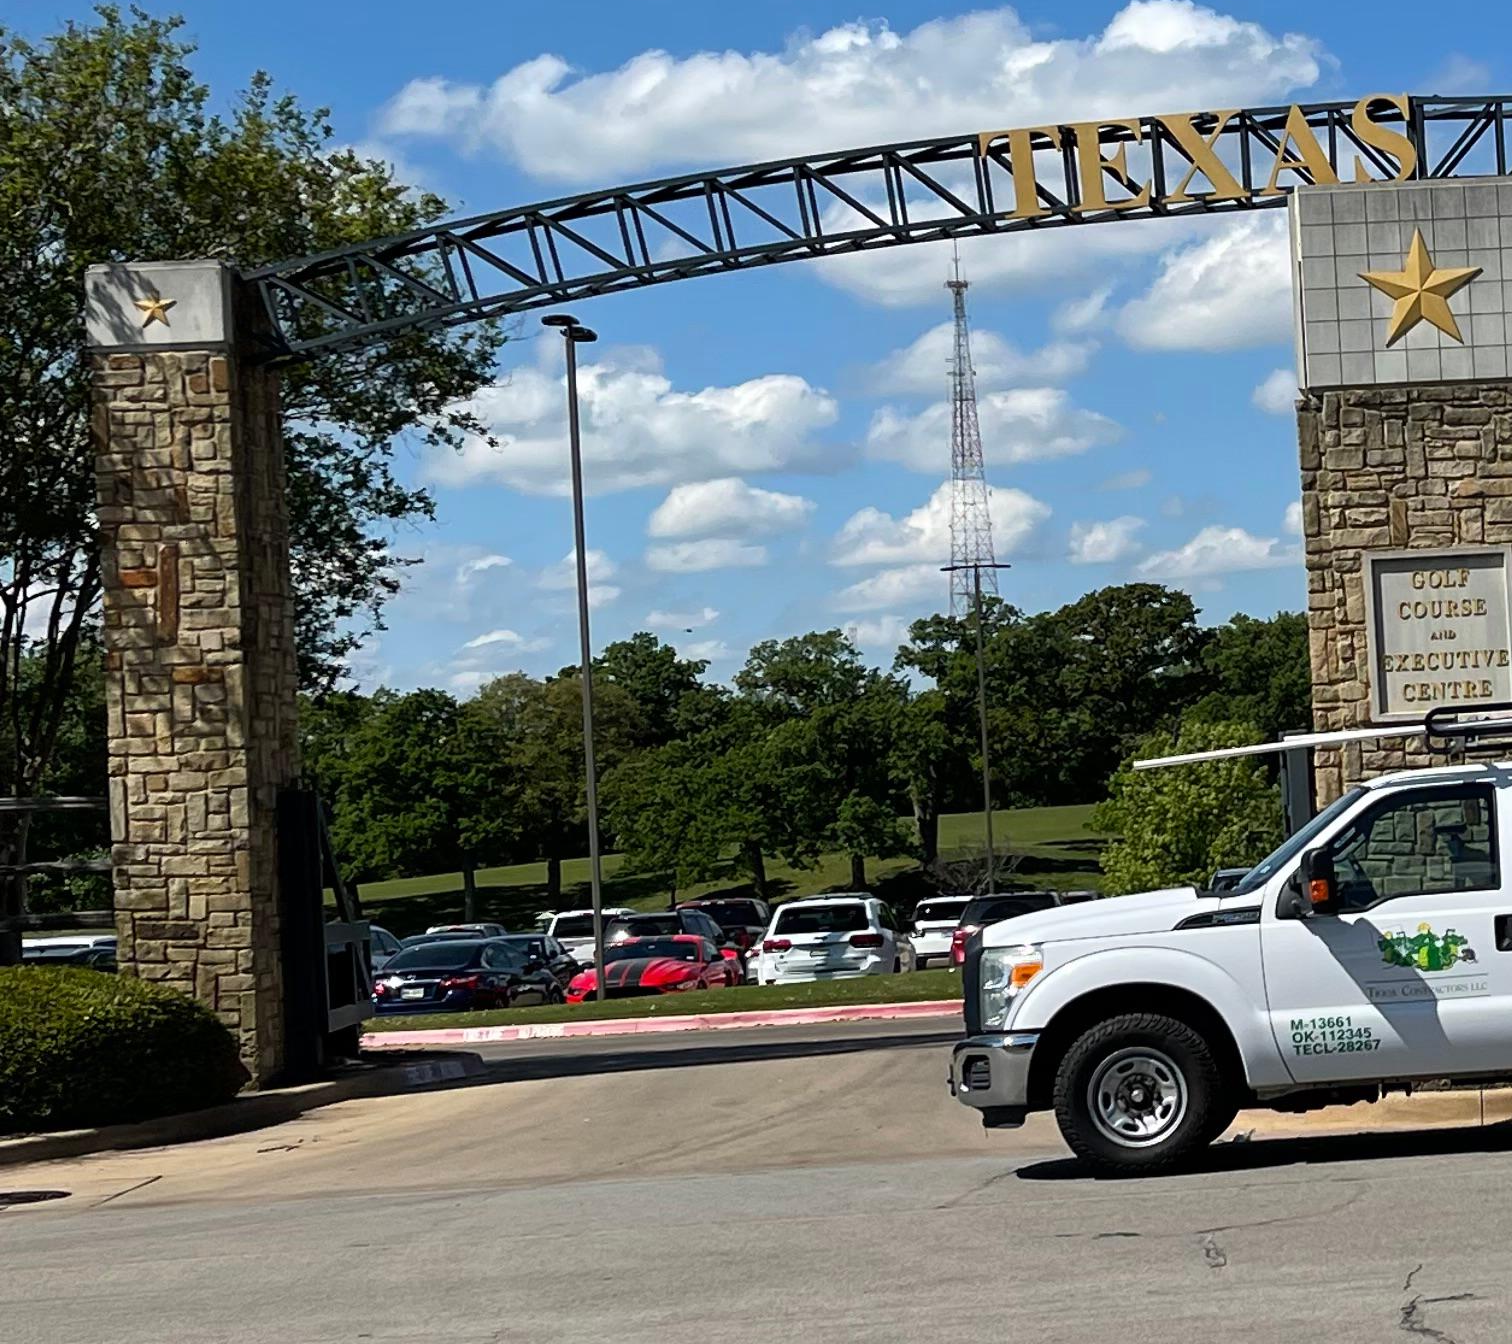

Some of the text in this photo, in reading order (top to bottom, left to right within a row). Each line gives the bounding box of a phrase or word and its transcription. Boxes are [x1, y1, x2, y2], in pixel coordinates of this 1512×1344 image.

[979, 92, 1417, 219] TEXAS
[1411, 568, 1471, 590] GOLF
[1398, 598, 1488, 621] COURSE
[1429, 629, 1457, 641] AND
[1382, 649, 1511, 673] EXECUTIVE
[1403, 679, 1493, 703] CENTRE
[1470, 981, 1488, 992] LLC
[1290, 1016, 1352, 1031] M-13661
[1292, 1027, 1372, 1044] OK-112345
[1293, 1039, 1381, 1056] TECL-28267
